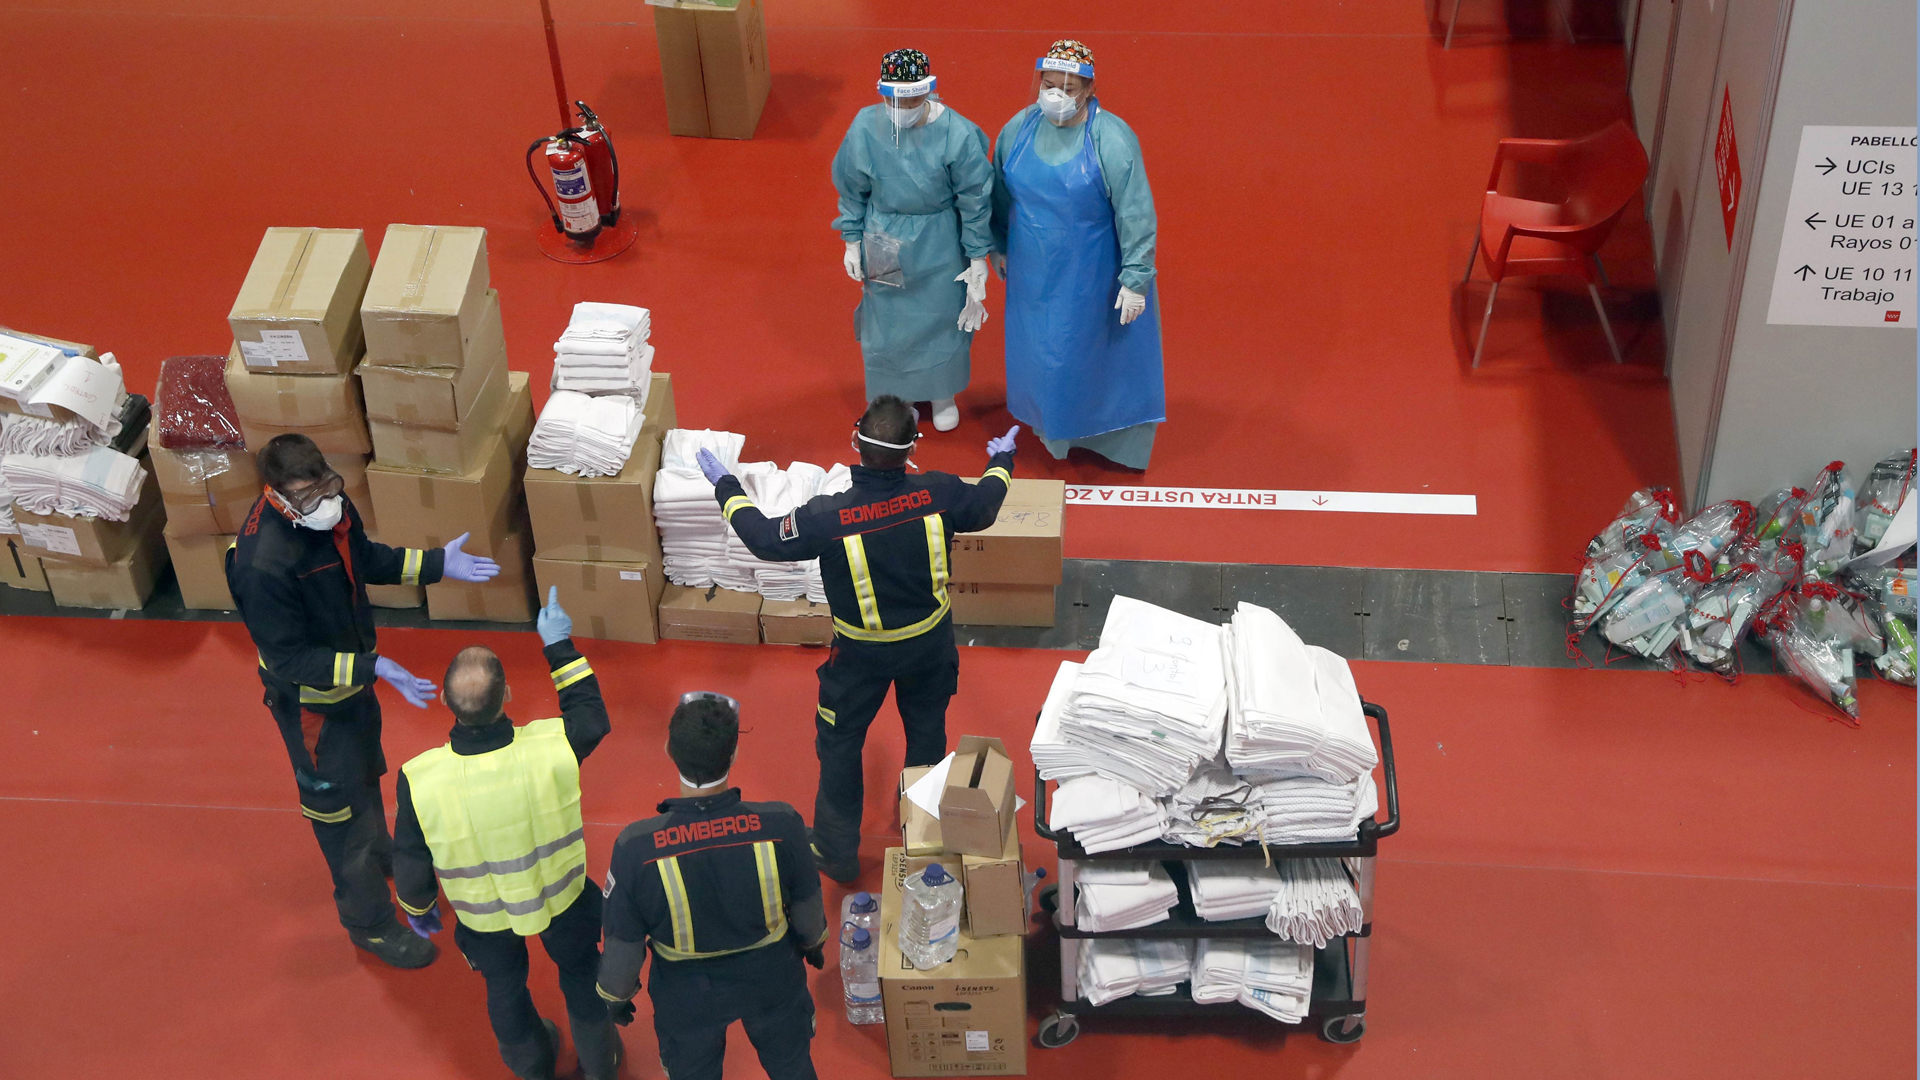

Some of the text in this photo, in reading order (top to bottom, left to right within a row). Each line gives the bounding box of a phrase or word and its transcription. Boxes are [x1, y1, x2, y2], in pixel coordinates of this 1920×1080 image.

[1057, 60, 1077, 69] Shield
[1846, 160, 1895, 175] UCIs
[1842, 181, 1872, 196] UE
[1881, 182, 1903, 196] 13
[1835, 214, 1915, 230] UE 01 a
[1830, 234, 1893, 253] Rayos
[1824, 266, 1912, 282] UE 10 11
[1821, 286, 1895, 305] Trabajo
[1098, 489, 1115, 500] A
[1120, 489, 1194, 503] USTED
[1201, 492, 1278, 506] ENTRA
[838, 489, 933, 526] BOMBEROS
[653, 814, 762, 849] BOMBEROS
[955, 984, 995, 992] i-SENSYS
